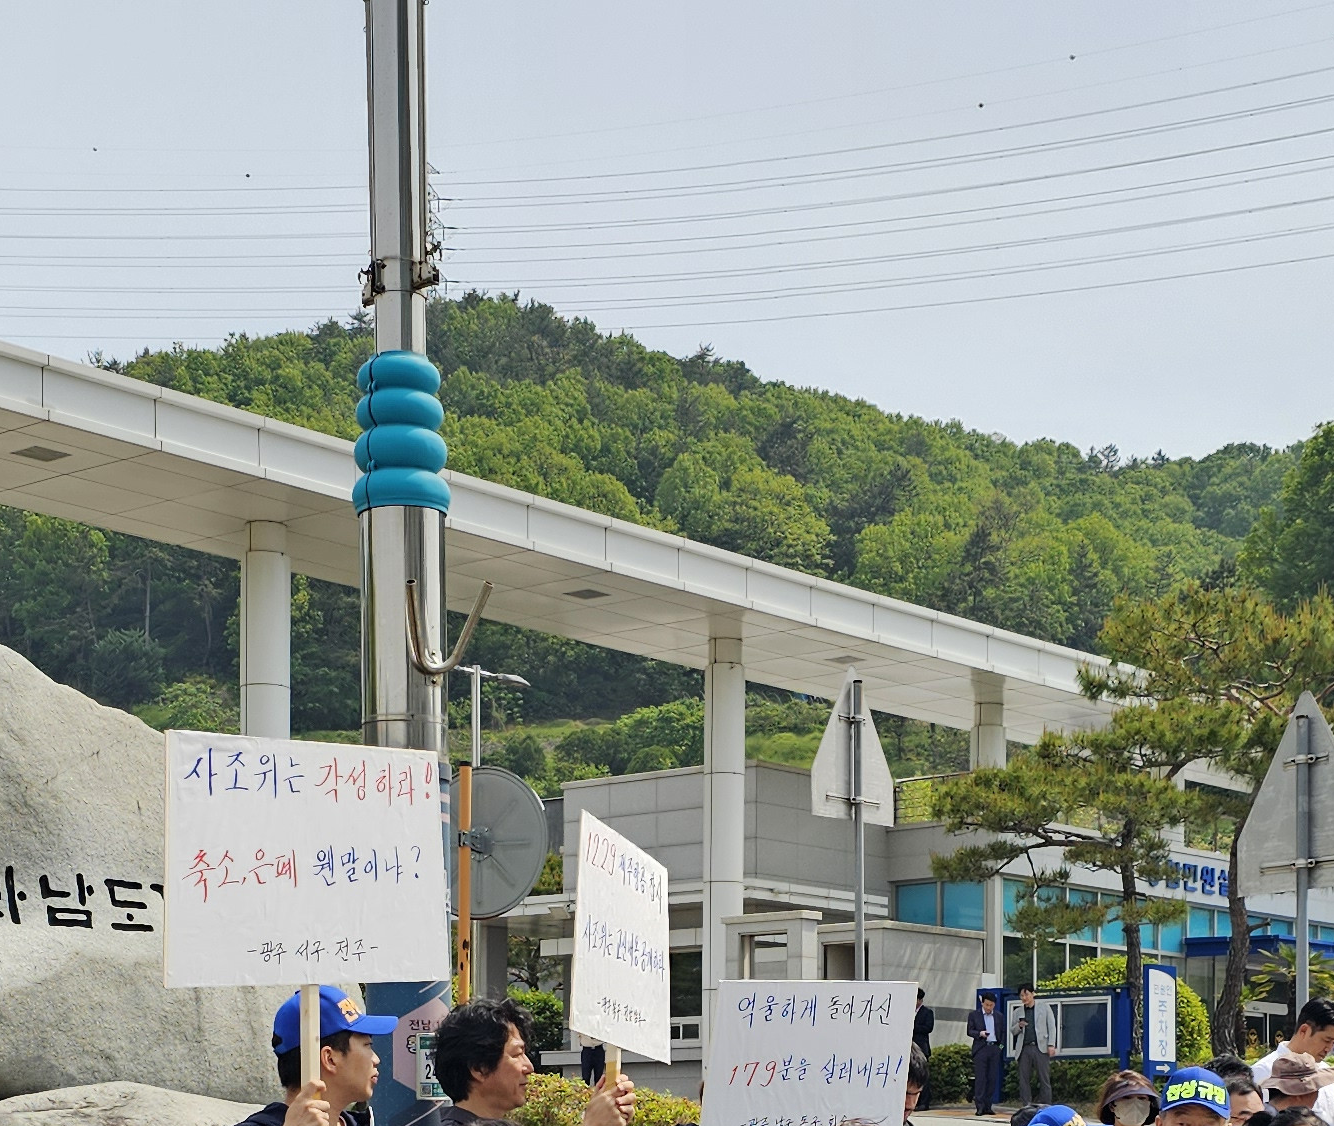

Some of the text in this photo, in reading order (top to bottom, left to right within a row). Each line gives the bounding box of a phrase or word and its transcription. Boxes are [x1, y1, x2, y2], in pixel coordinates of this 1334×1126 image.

[184, 748, 304, 798] 사조위는
[738, 992, 892, 1029] 억울하게 돌아가신
[729, 1054, 903, 1088] 179분을 살려내라!
